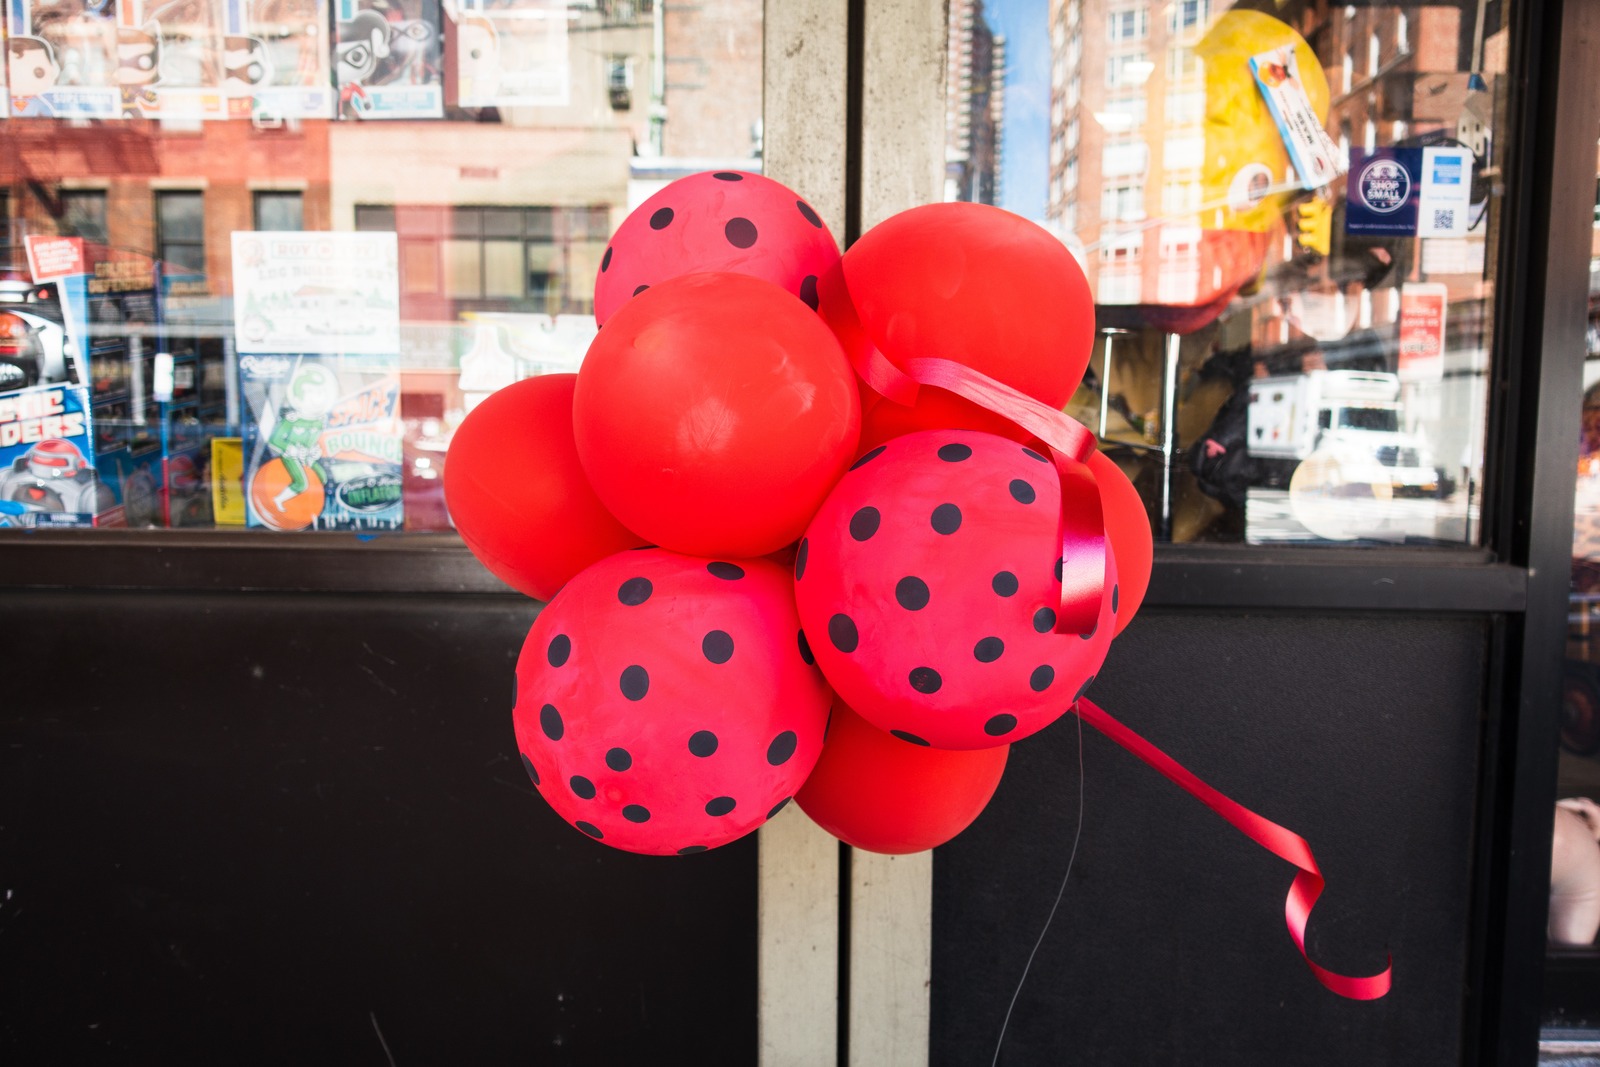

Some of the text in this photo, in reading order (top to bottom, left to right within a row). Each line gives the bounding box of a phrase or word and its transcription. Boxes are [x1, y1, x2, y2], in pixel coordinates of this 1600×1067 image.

[1369, 180, 1400, 190] SHOP
[1366, 189, 1401, 200] SMALL
[329, 381, 397, 425] SPACE
